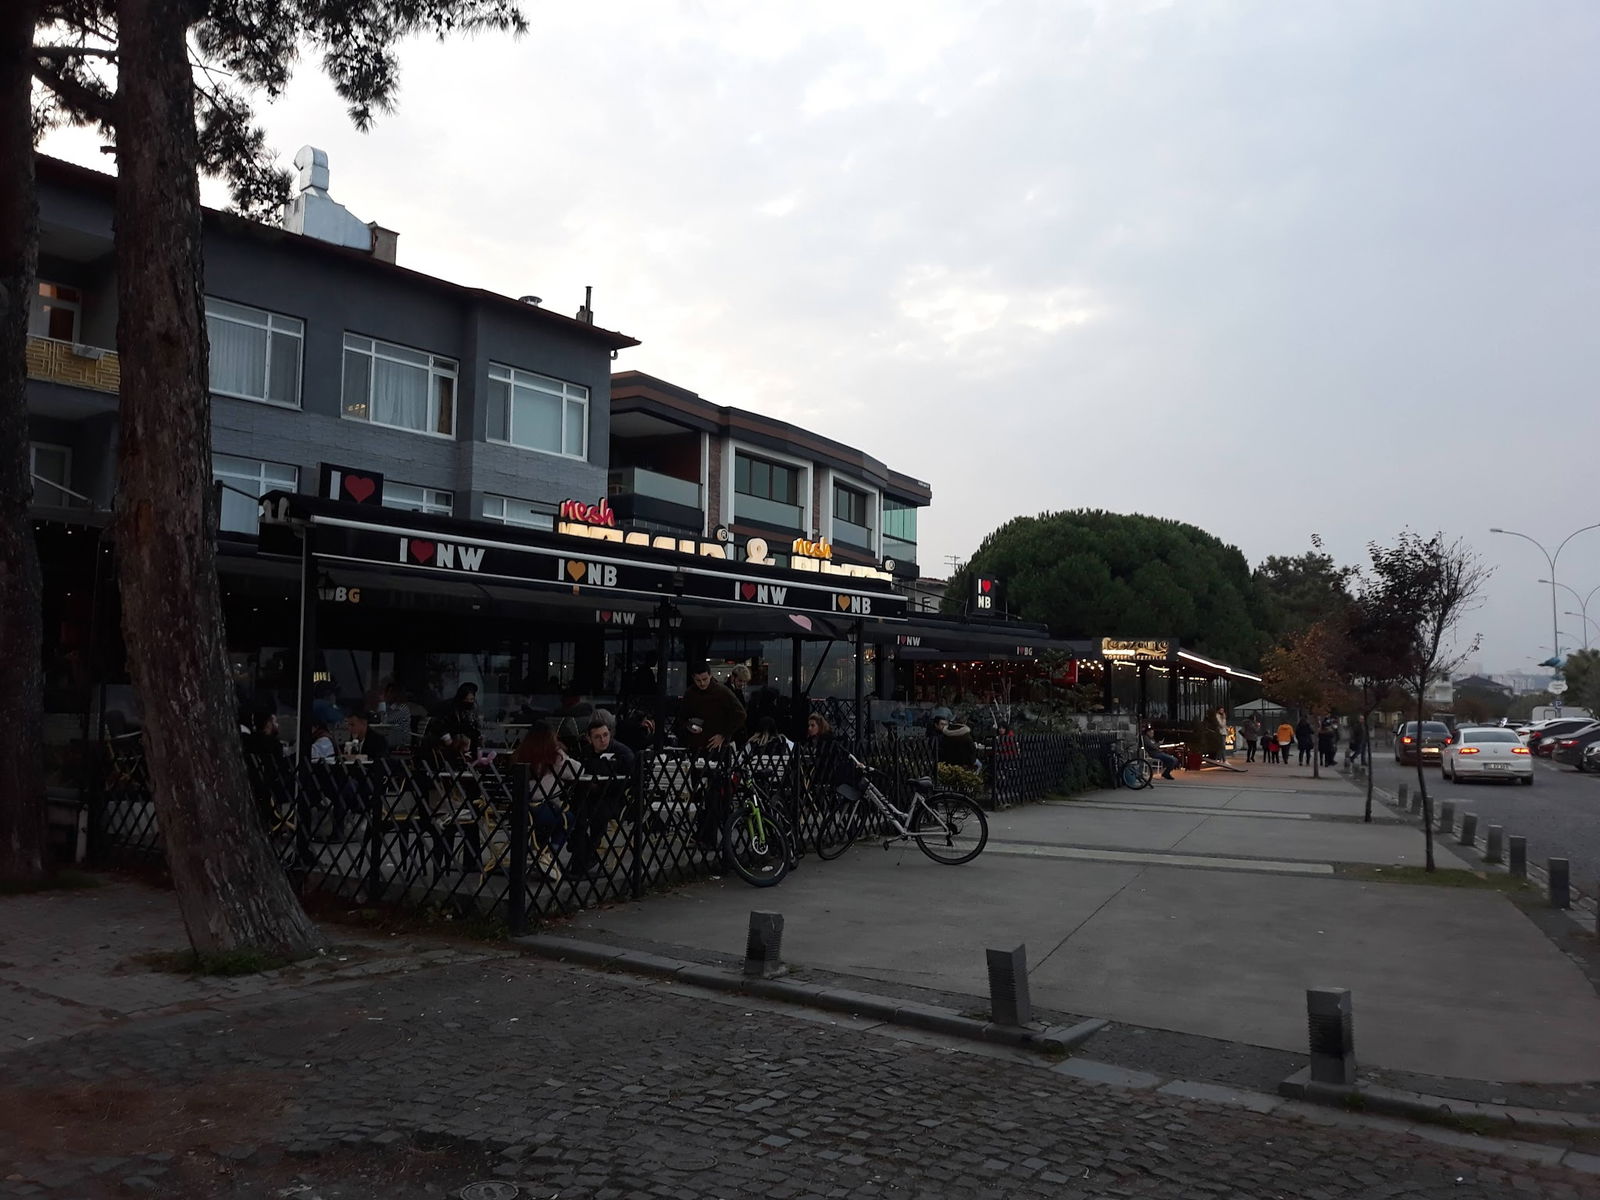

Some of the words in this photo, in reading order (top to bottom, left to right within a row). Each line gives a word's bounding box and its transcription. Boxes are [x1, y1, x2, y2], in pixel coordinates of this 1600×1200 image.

[560, 497, 616, 527] nesh
[399, 538, 408, 562] I
[436, 543, 485, 571] NW
[793, 536, 832, 559] nesh
[558, 558, 565, 581] I
[587, 563, 618, 587] NB
[734, 581, 741, 600] I
[757, 584, 787, 605] NW
[977, 578, 982, 594] I
[832, 594, 837, 611] I
[851, 597, 871, 614] NB
[977, 595, 992, 609] NB
[613, 611, 636, 624] NW
[906, 636, 921, 646] NW
